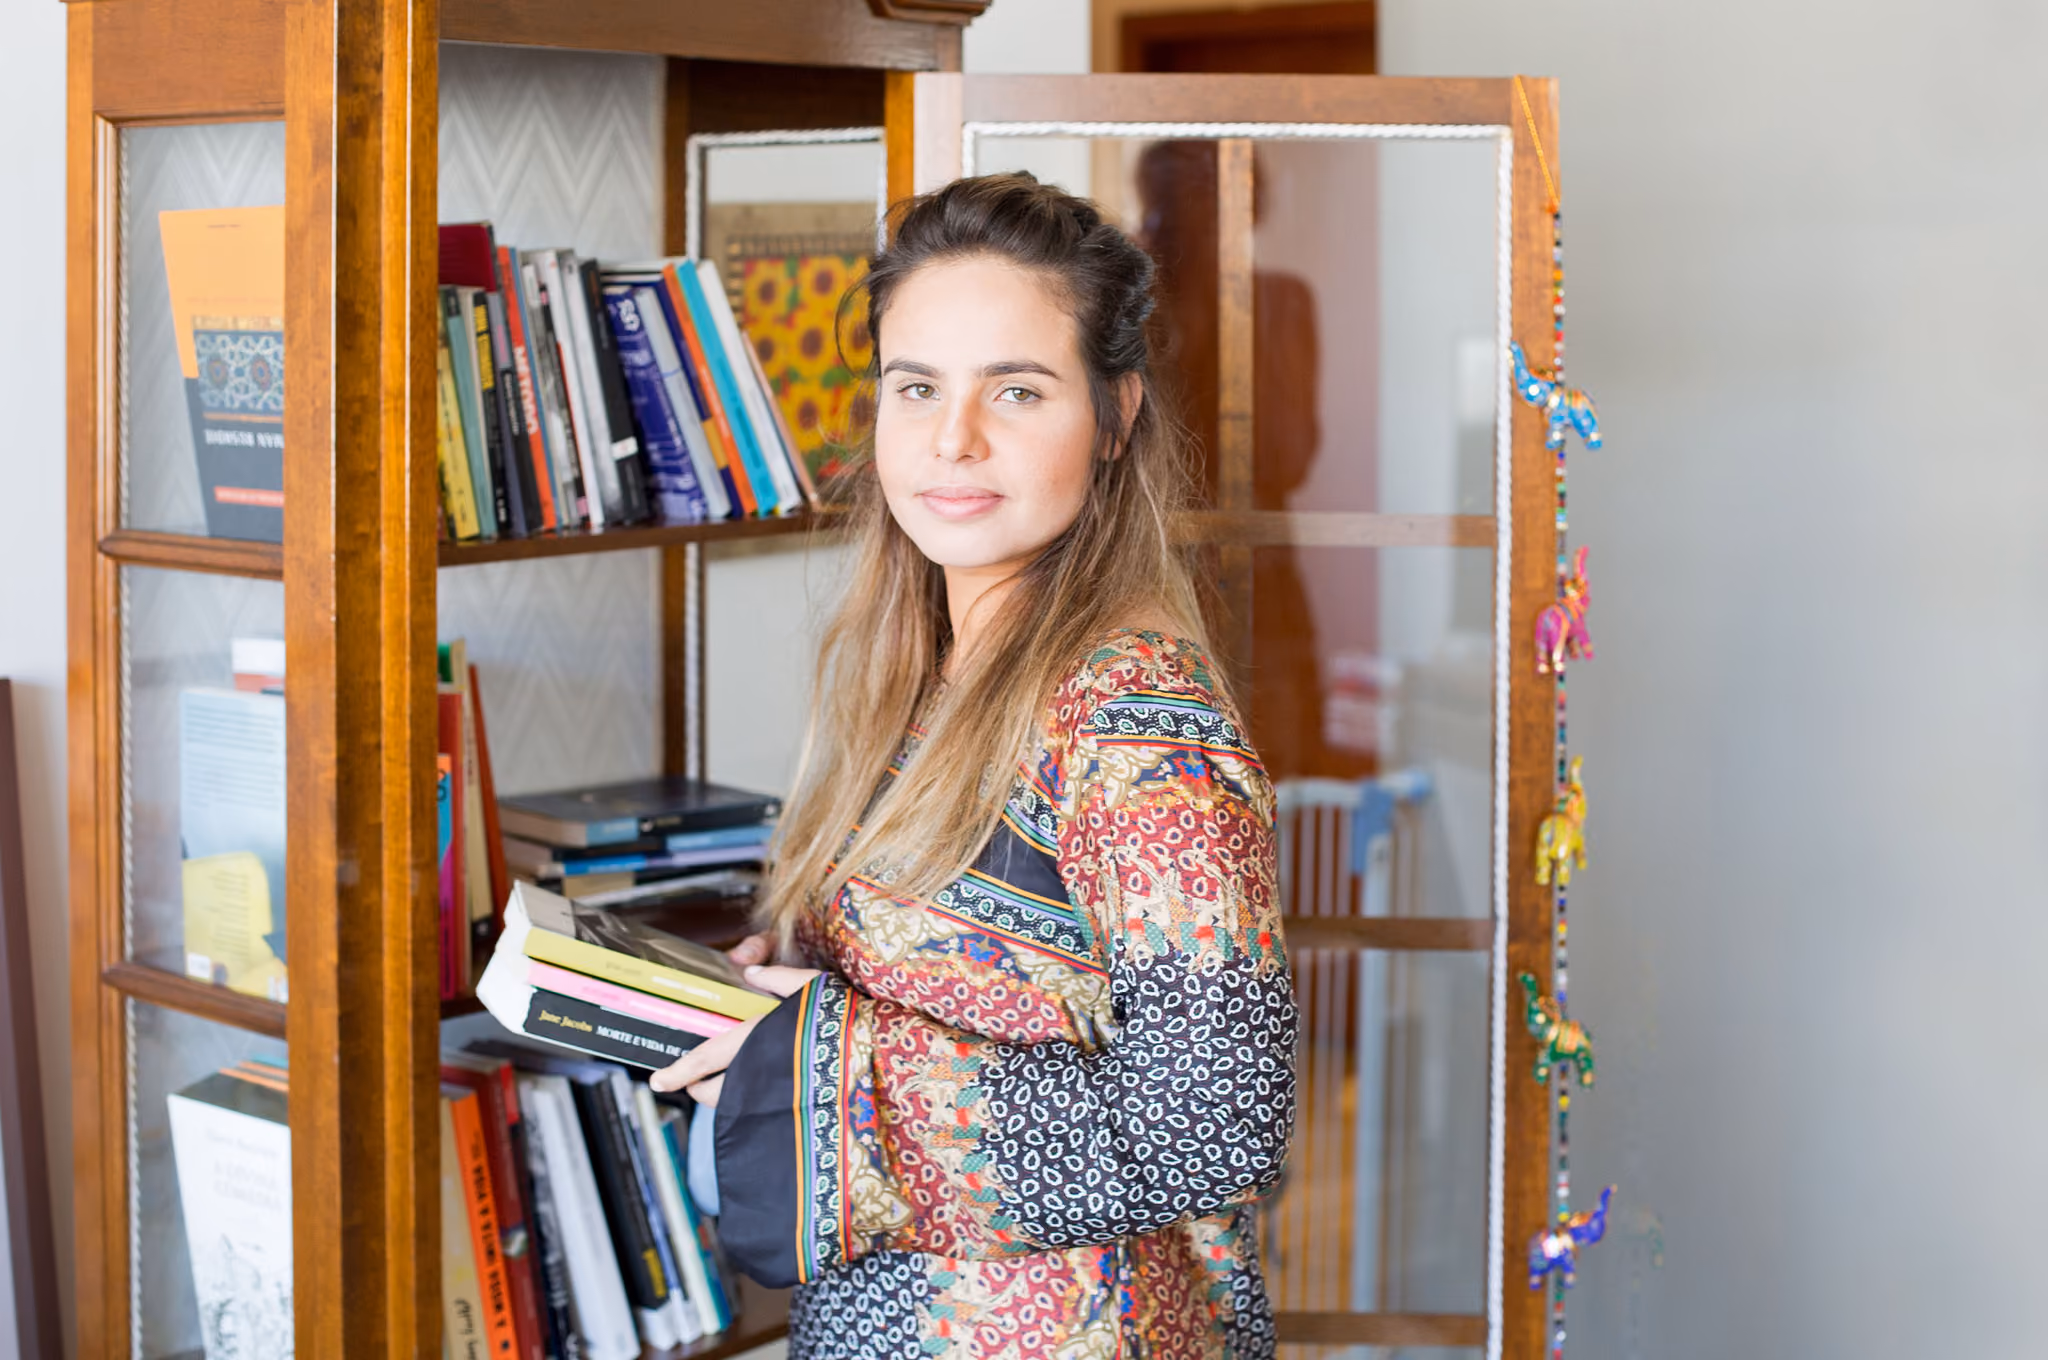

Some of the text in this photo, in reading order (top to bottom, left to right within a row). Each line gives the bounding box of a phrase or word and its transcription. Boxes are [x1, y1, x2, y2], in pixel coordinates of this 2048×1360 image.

[538, 1009, 562, 1024] Jane
[560, 1016, 593, 1032] Jacobs
[596, 1025, 633, 1044] MORTE
[640, 1037, 664, 1053] VIDA
[665, 1044, 682, 1057] DE
